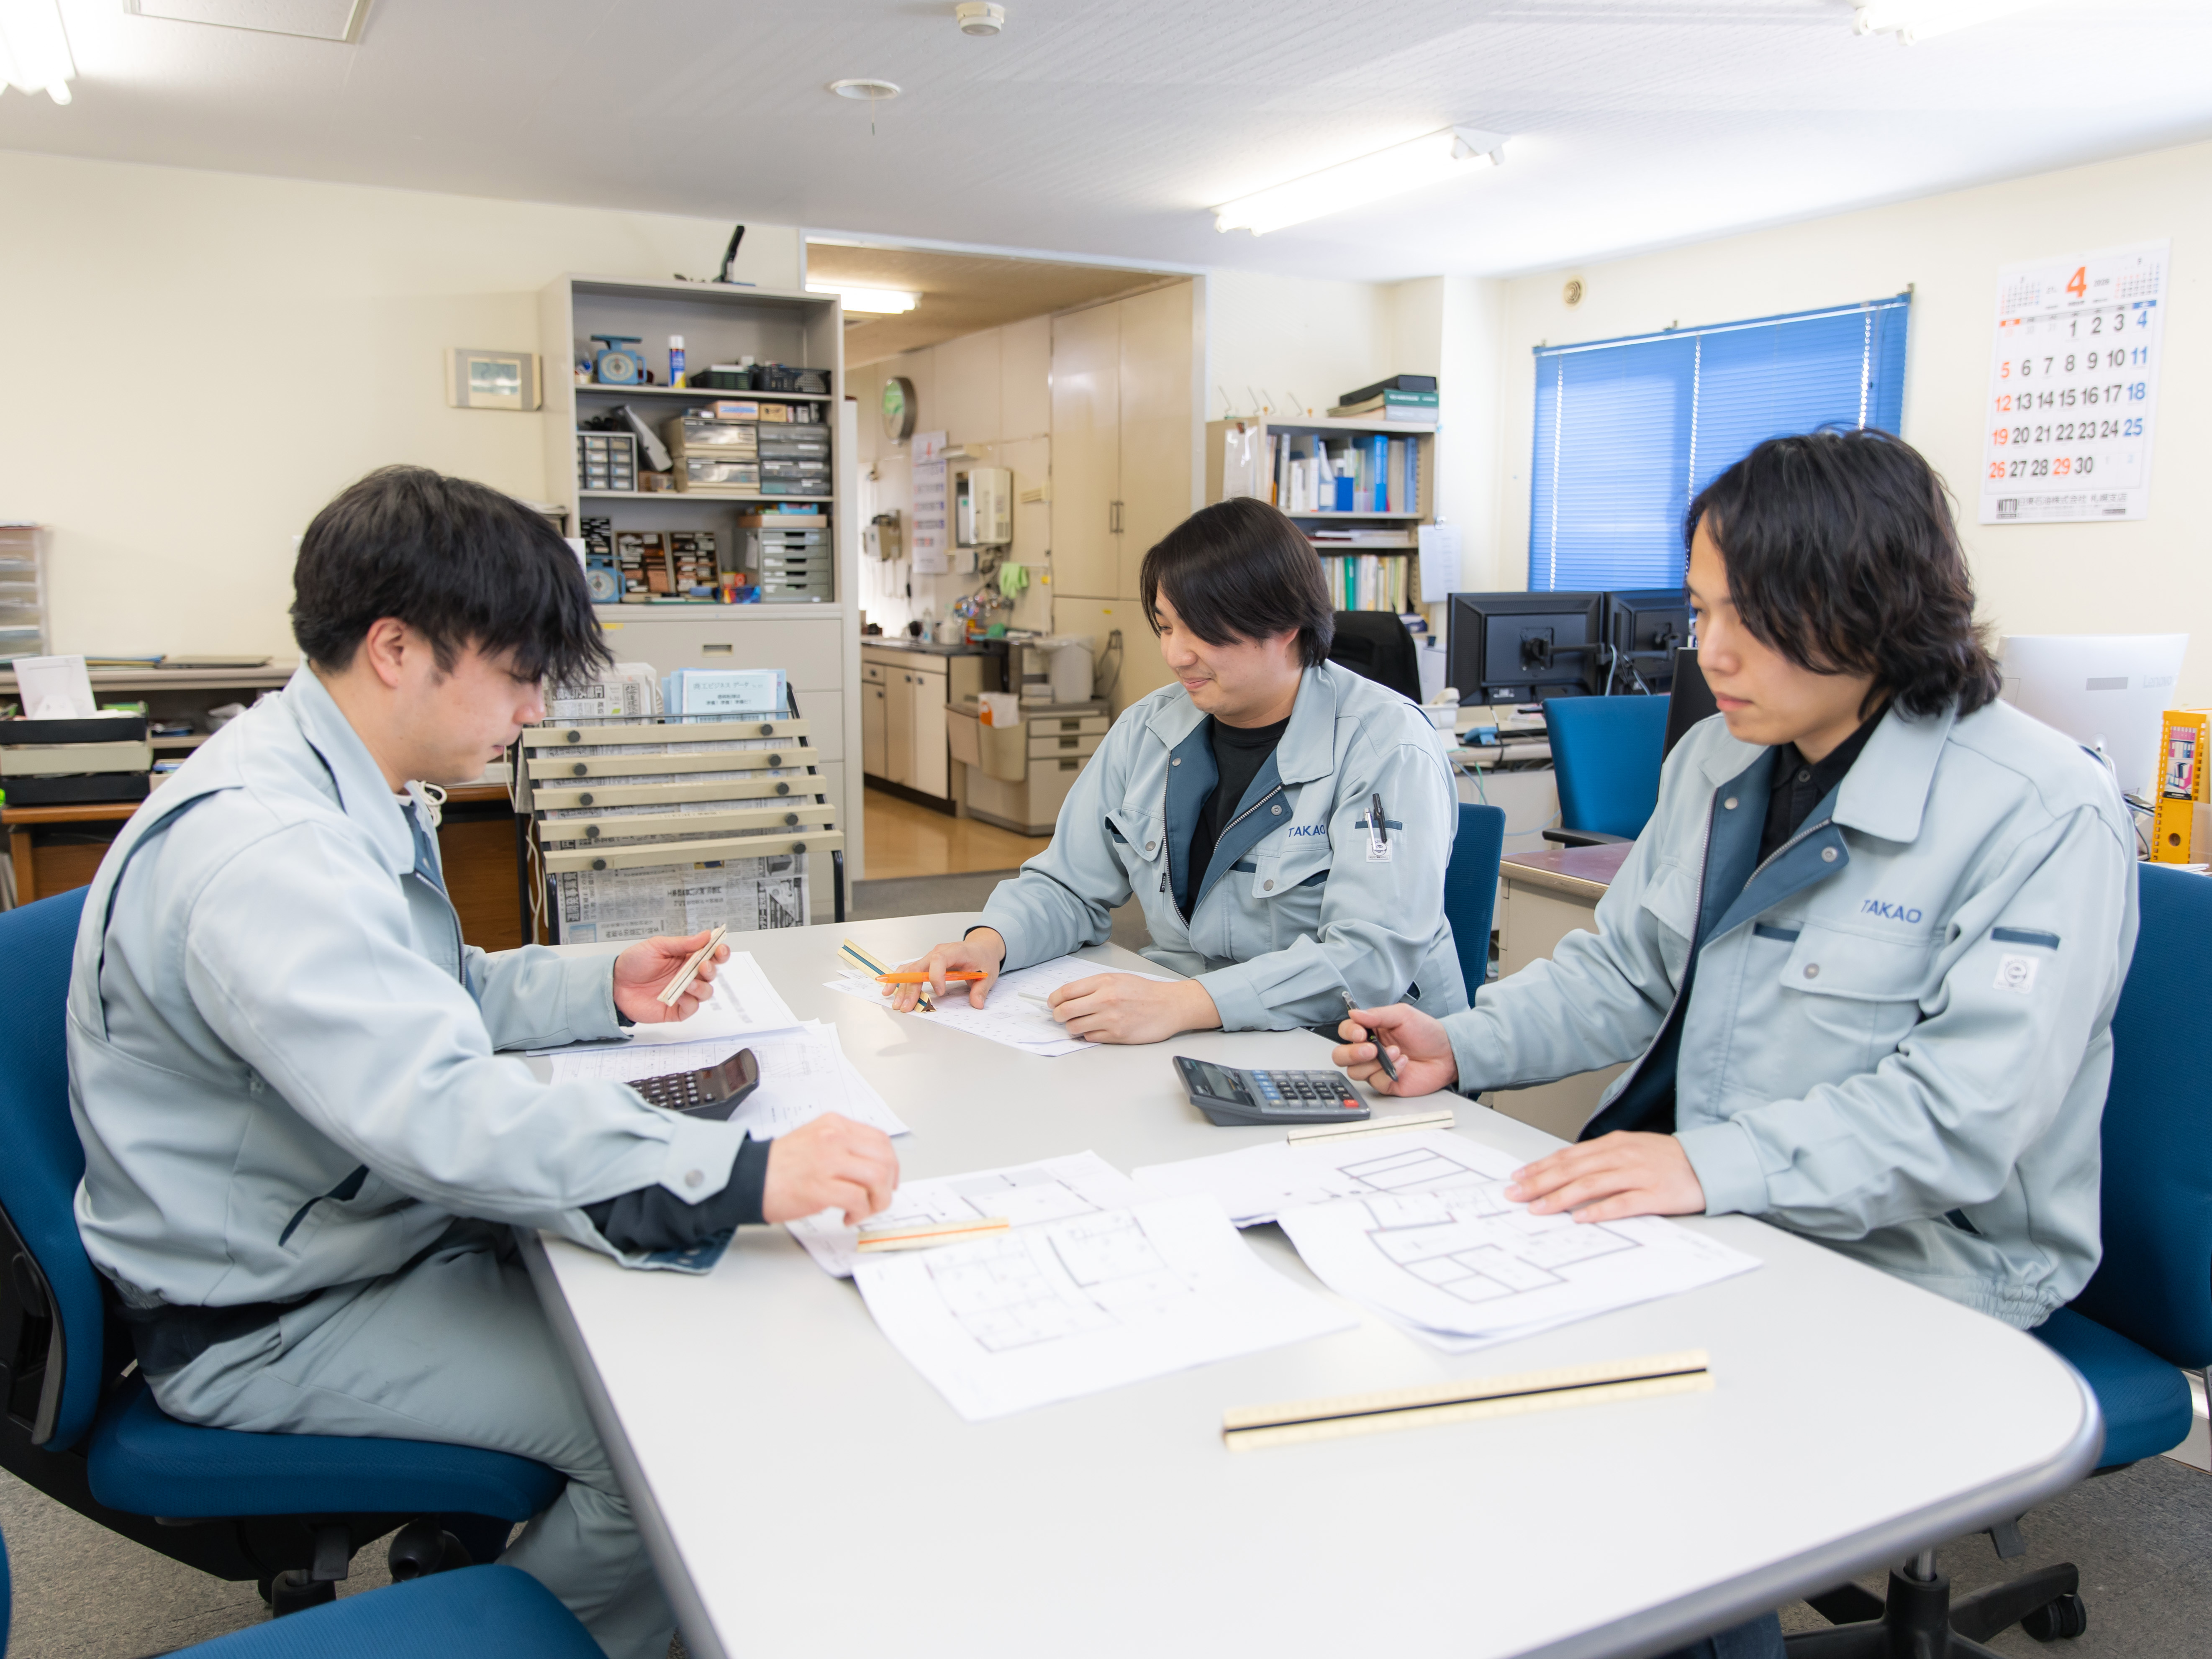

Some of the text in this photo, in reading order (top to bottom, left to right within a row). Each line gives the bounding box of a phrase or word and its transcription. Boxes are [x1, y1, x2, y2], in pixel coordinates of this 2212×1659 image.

[2066, 266, 2087, 297] 4
[2069, 320, 2077, 337] 1
[2091, 317, 2102, 334] 2
[2113, 313, 2125, 332] 3
[2135, 310, 2148, 328] 4
[2001, 346, 2148, 378] 5 6 7 8 9 10 11
[1996, 382, 2146, 411] 12 13 14 15 16 17 18
[1993, 418, 2143, 445] 19 20 21 22 23 24 25
[1989, 462, 2006, 478] 26
[2009, 460, 2028, 477] 27
[2030, 459, 2049, 476] 28
[2053, 458, 2071, 475] 29
[2074, 456, 2094, 474] 30
[2143, 675, 2173, 688] Lenovo
[1288, 825, 1326, 837] TAKAO
[1861, 899, 1922, 923] TAKAO
